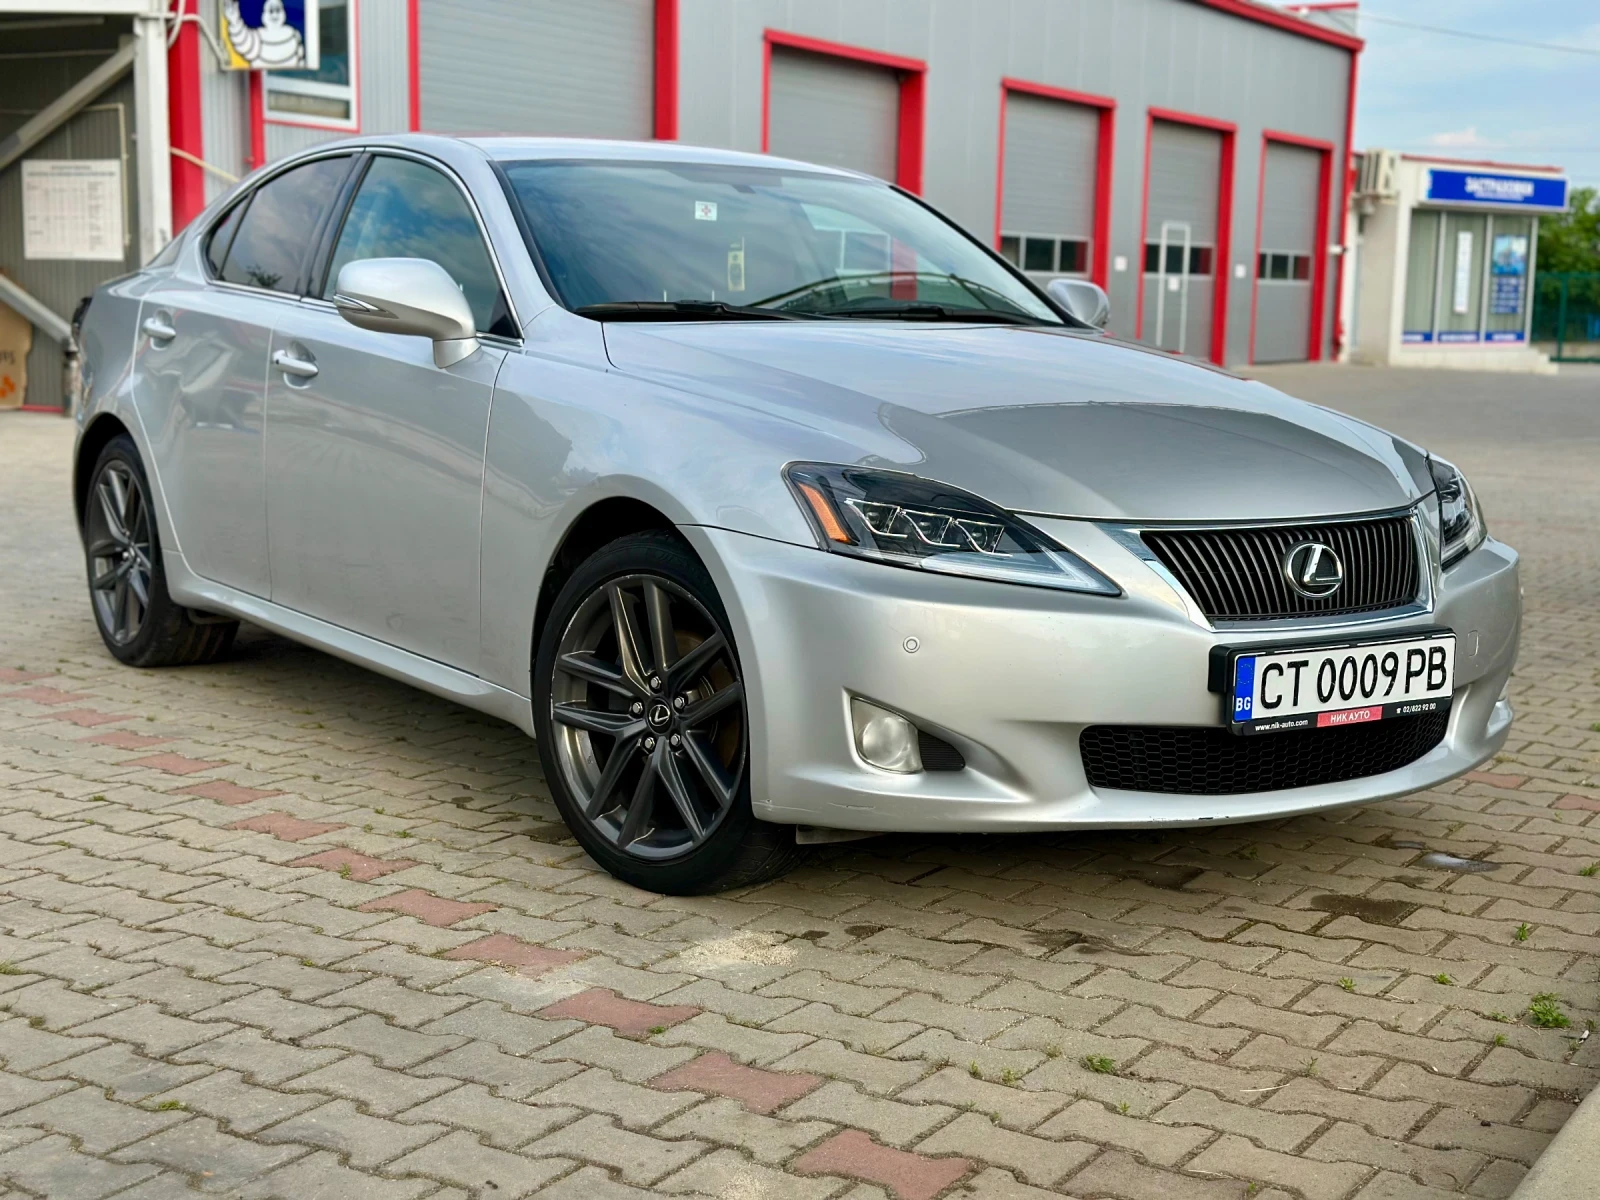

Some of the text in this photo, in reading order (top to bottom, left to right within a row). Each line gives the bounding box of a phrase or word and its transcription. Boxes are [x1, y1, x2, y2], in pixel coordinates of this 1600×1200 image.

[1260, 646, 1447, 710] CT 0009 PB
[1235, 697, 1251, 712] BG
[1330, 710, 1371, 724] НИК АУТО
[1255, 719, 1309, 732] www.nik-auto.com
